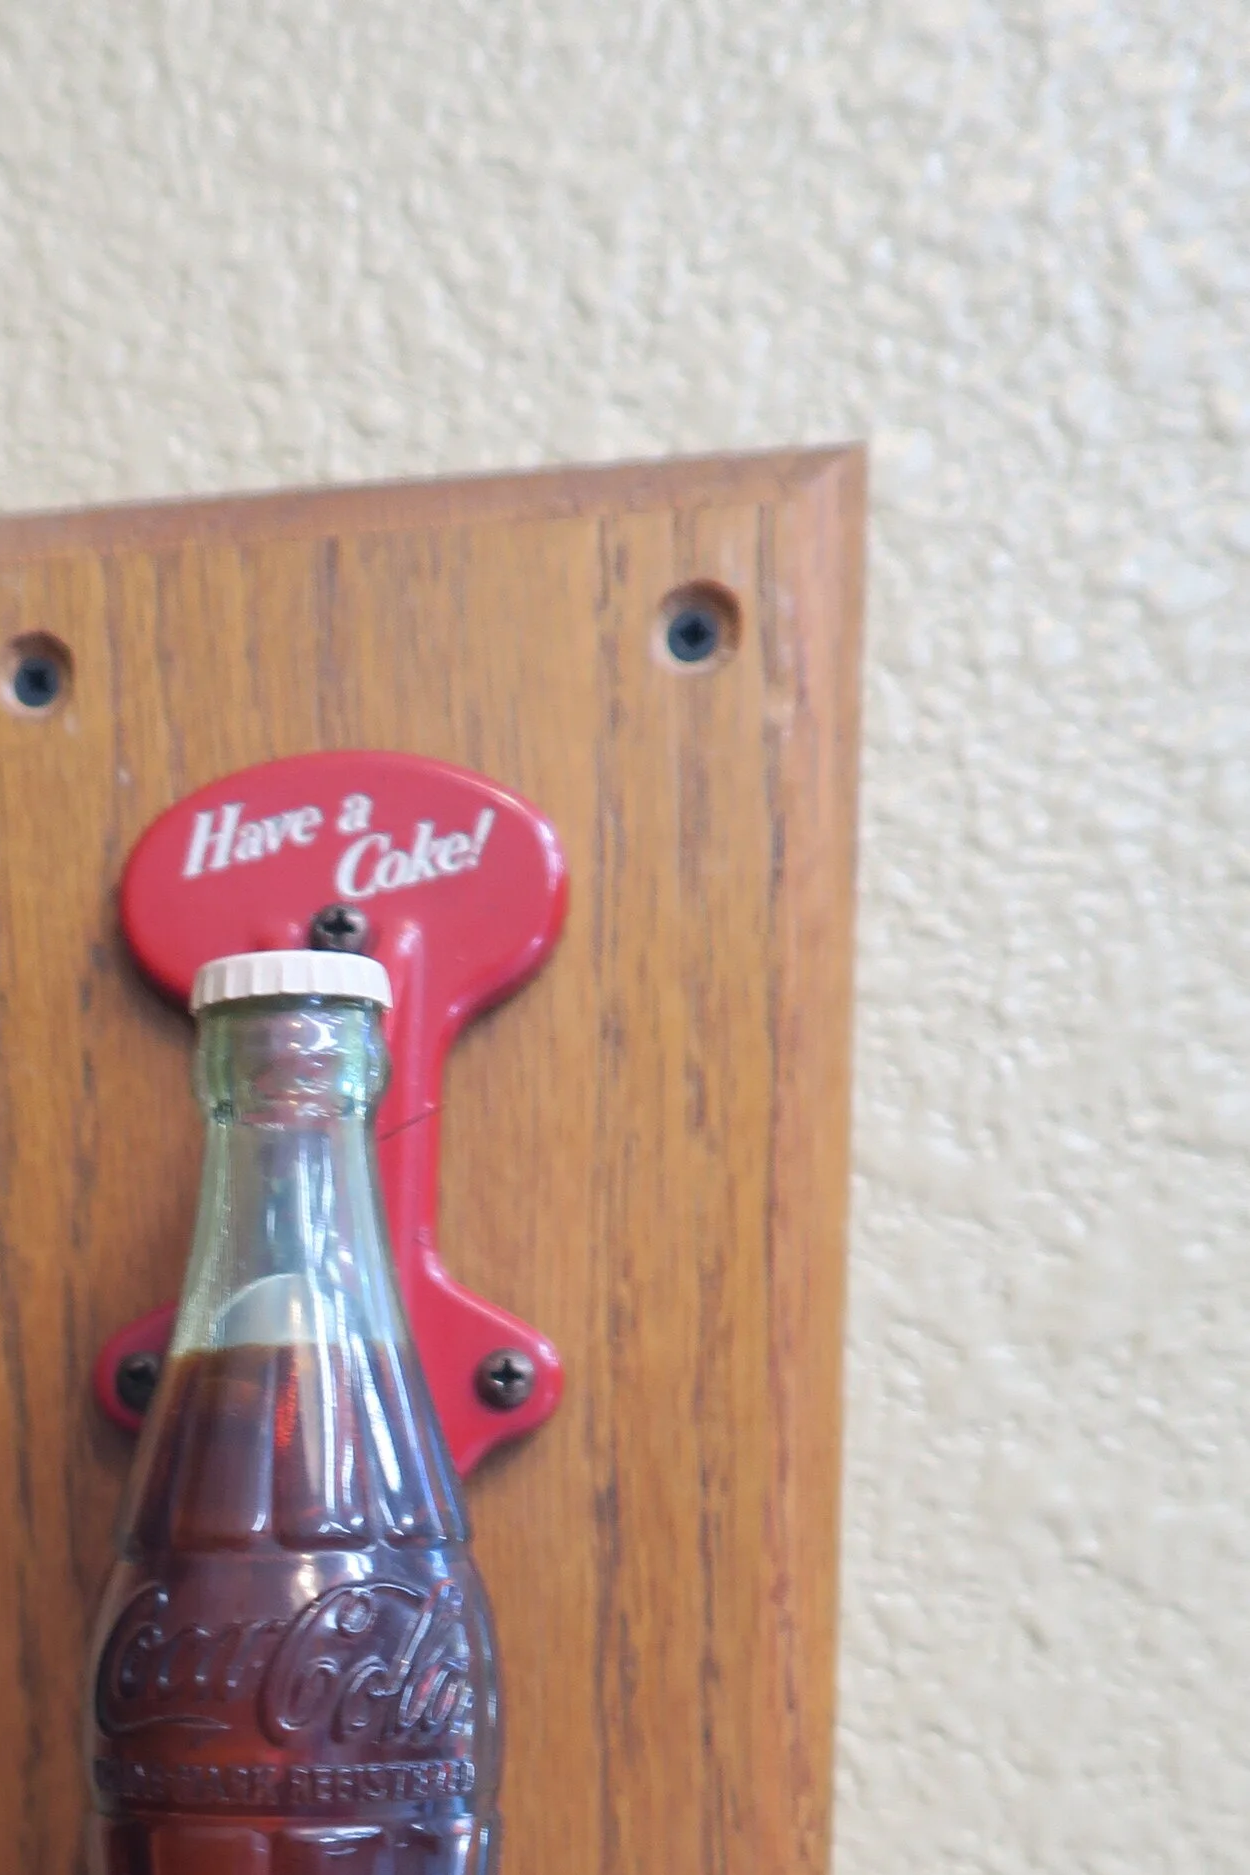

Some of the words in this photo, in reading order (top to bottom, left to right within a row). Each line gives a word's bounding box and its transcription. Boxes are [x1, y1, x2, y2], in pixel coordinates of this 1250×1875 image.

[183, 802, 324, 880] Have
[337, 793, 373, 835] a
[335, 808, 496, 899] Coke!
